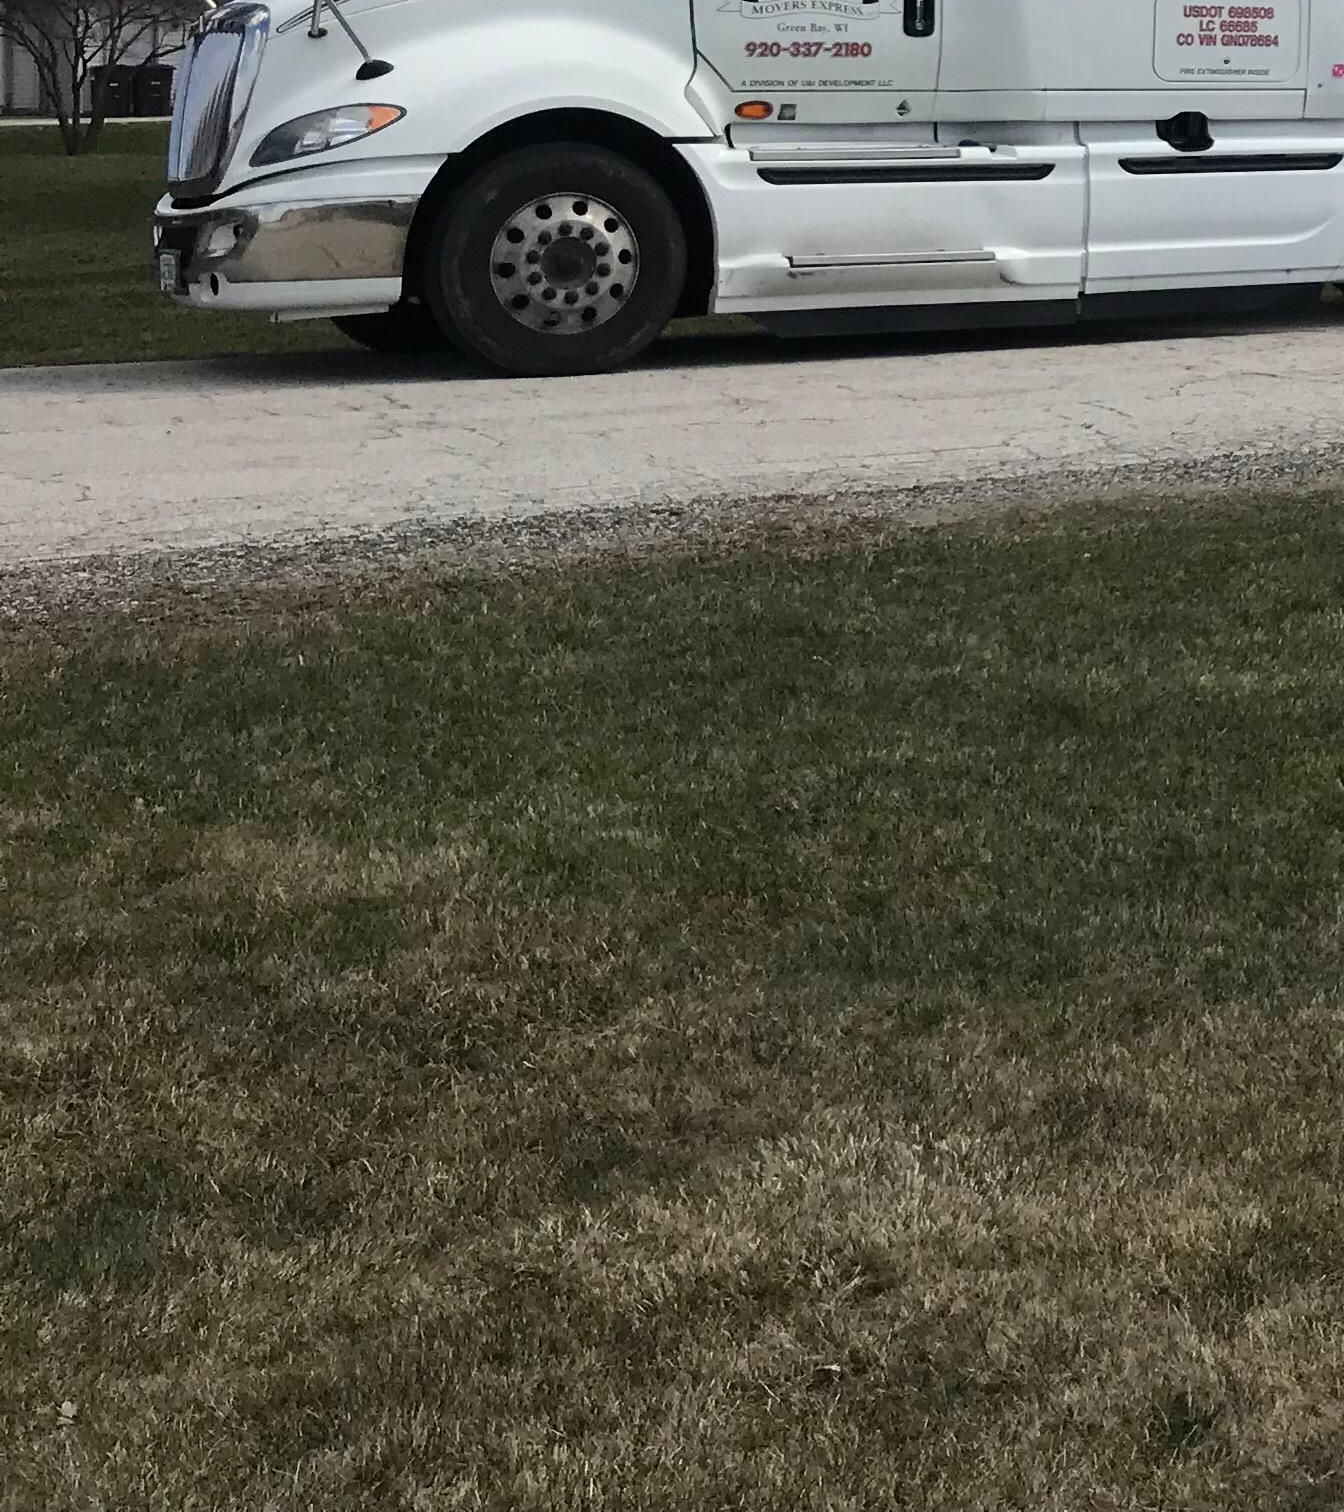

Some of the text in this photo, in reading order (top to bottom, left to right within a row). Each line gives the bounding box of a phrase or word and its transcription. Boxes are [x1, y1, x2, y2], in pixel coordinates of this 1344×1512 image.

[751, 0, 864, 16] MOVERS EXPRESS
[1183, 5, 1224, 18] USDOT
[777, 23, 806, 33] Green
[834, 23, 849, 32] WI
[1199, 20, 1216, 32] LC
[1176, 33, 1195, 46] CO
[1199, 34, 1217, 46] VIN
[744, 41, 873, 58] 920-337-2180
[740, 79, 747, 87] A
[749, 79, 785, 87] DIVISION
[788, 79, 799, 87] OF
[818, 79, 876, 87] DEVELOPMENT
[878, 79, 895, 87] LLC
